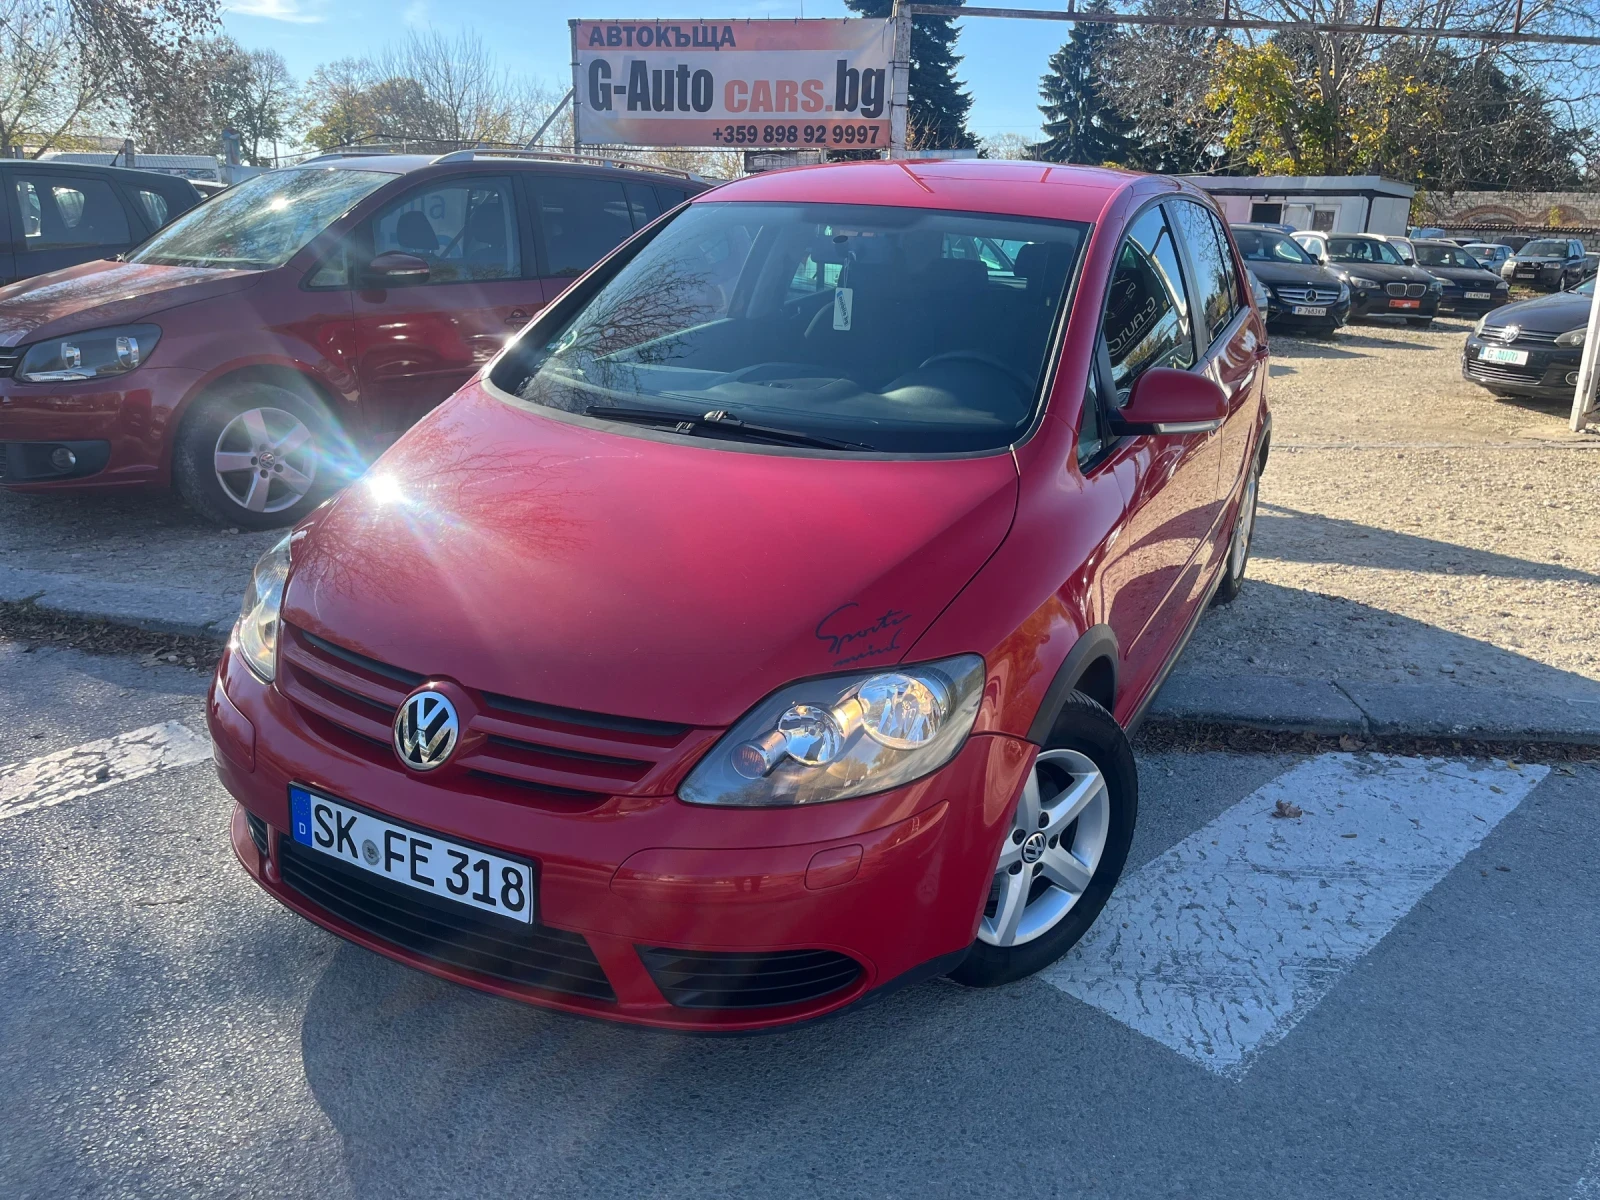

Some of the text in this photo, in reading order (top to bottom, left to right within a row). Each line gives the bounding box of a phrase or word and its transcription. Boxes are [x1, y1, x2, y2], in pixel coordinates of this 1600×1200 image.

[588, 25, 736, 51] АВТОКЪЩА
[588, 58, 714, 112] G-Auto
[712, 125, 880, 144] +359 898 92 9997
[299, 822, 306, 836] D
[314, 804, 525, 912] SK FE 318
